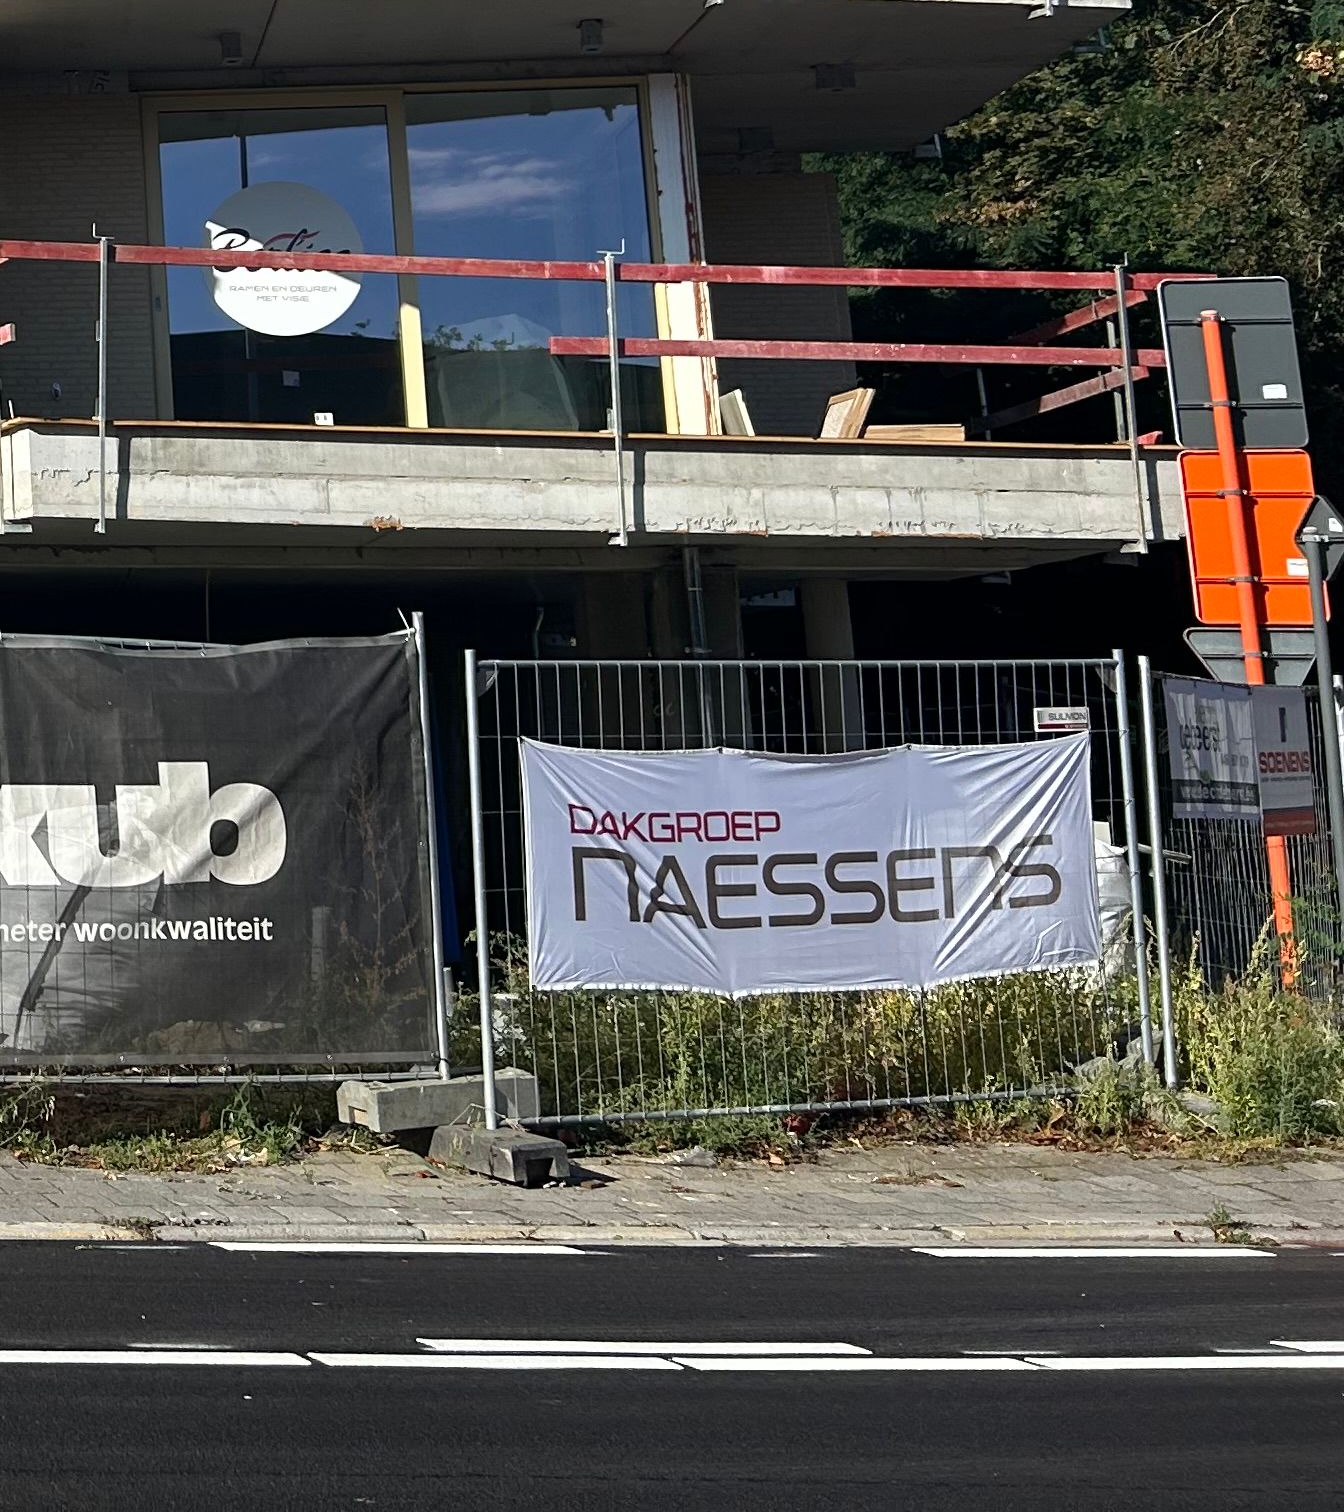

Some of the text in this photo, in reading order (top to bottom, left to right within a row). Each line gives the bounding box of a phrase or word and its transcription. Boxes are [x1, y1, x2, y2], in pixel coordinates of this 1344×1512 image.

[568, 804, 781, 843] DAKGROEP
[571, 834, 1062, 930] NAESSENS
[73, 916, 274, 942] woonkwaliteit
